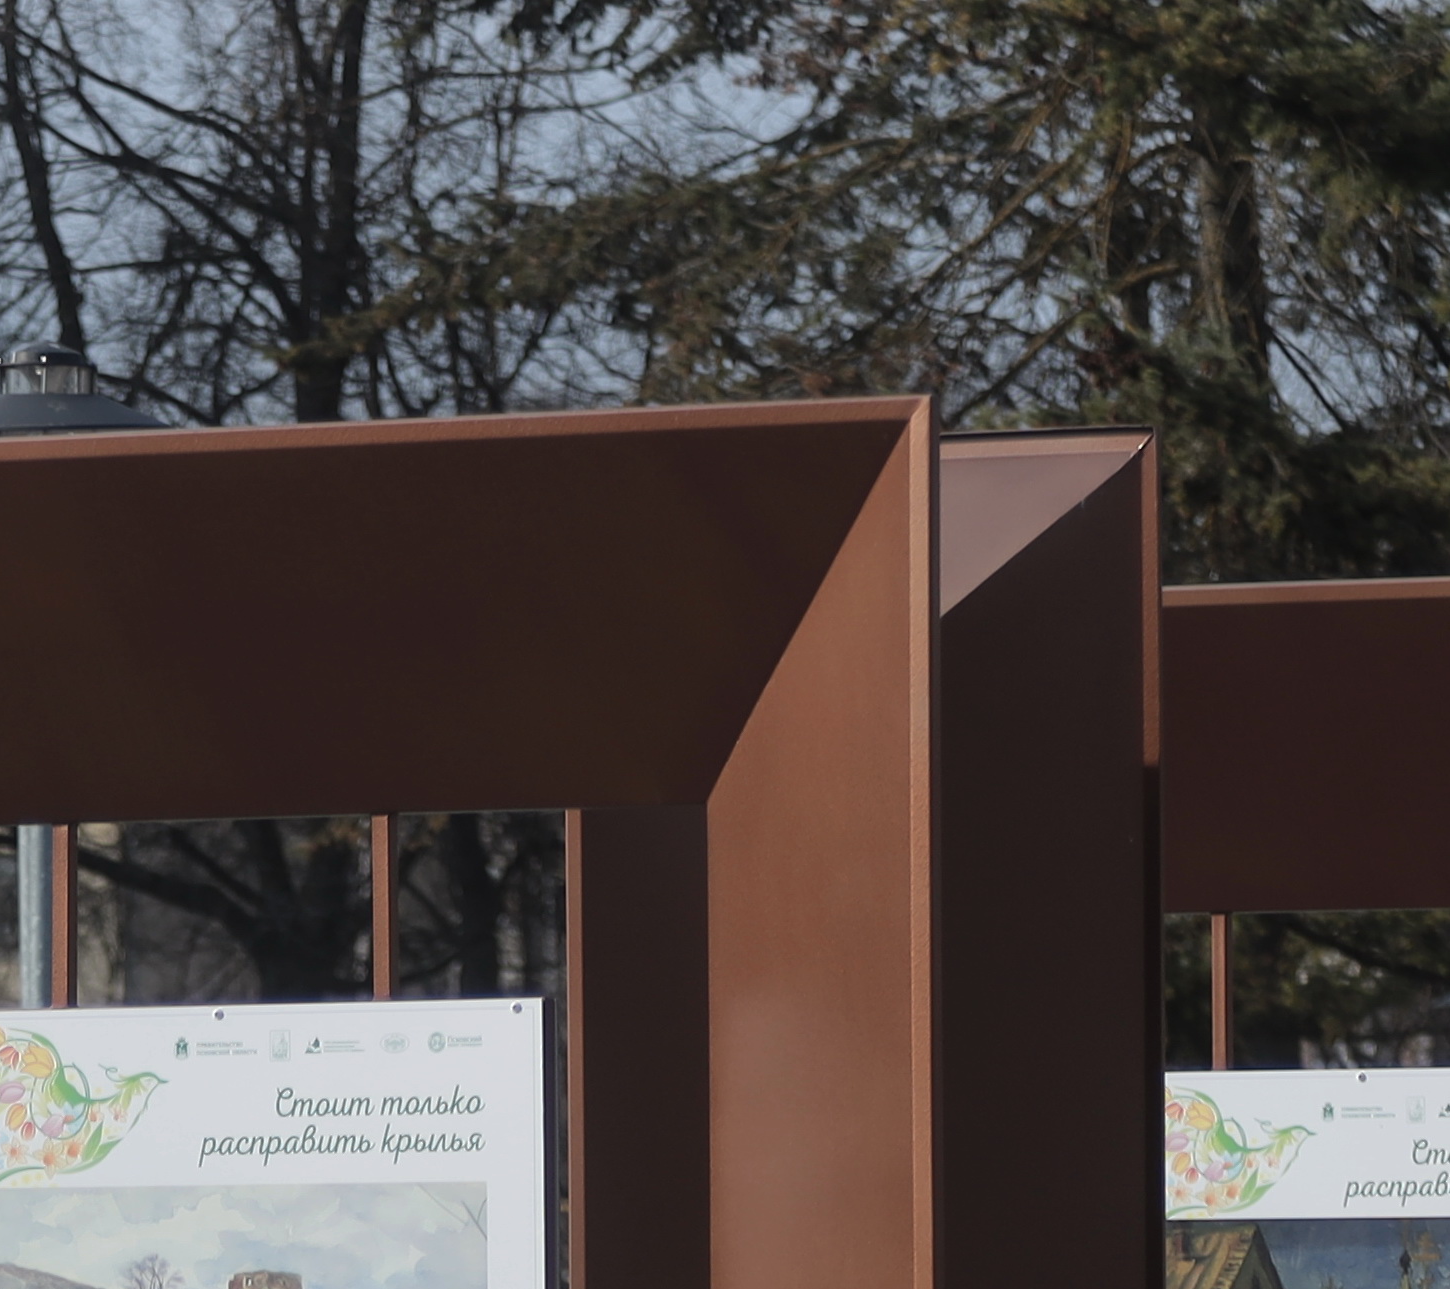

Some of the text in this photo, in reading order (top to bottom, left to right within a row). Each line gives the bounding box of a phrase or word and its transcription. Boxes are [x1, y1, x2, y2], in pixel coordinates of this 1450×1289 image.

[276, 1084, 485, 1117] Стоит только
[199, 1122, 486, 1168] расправить крылья
